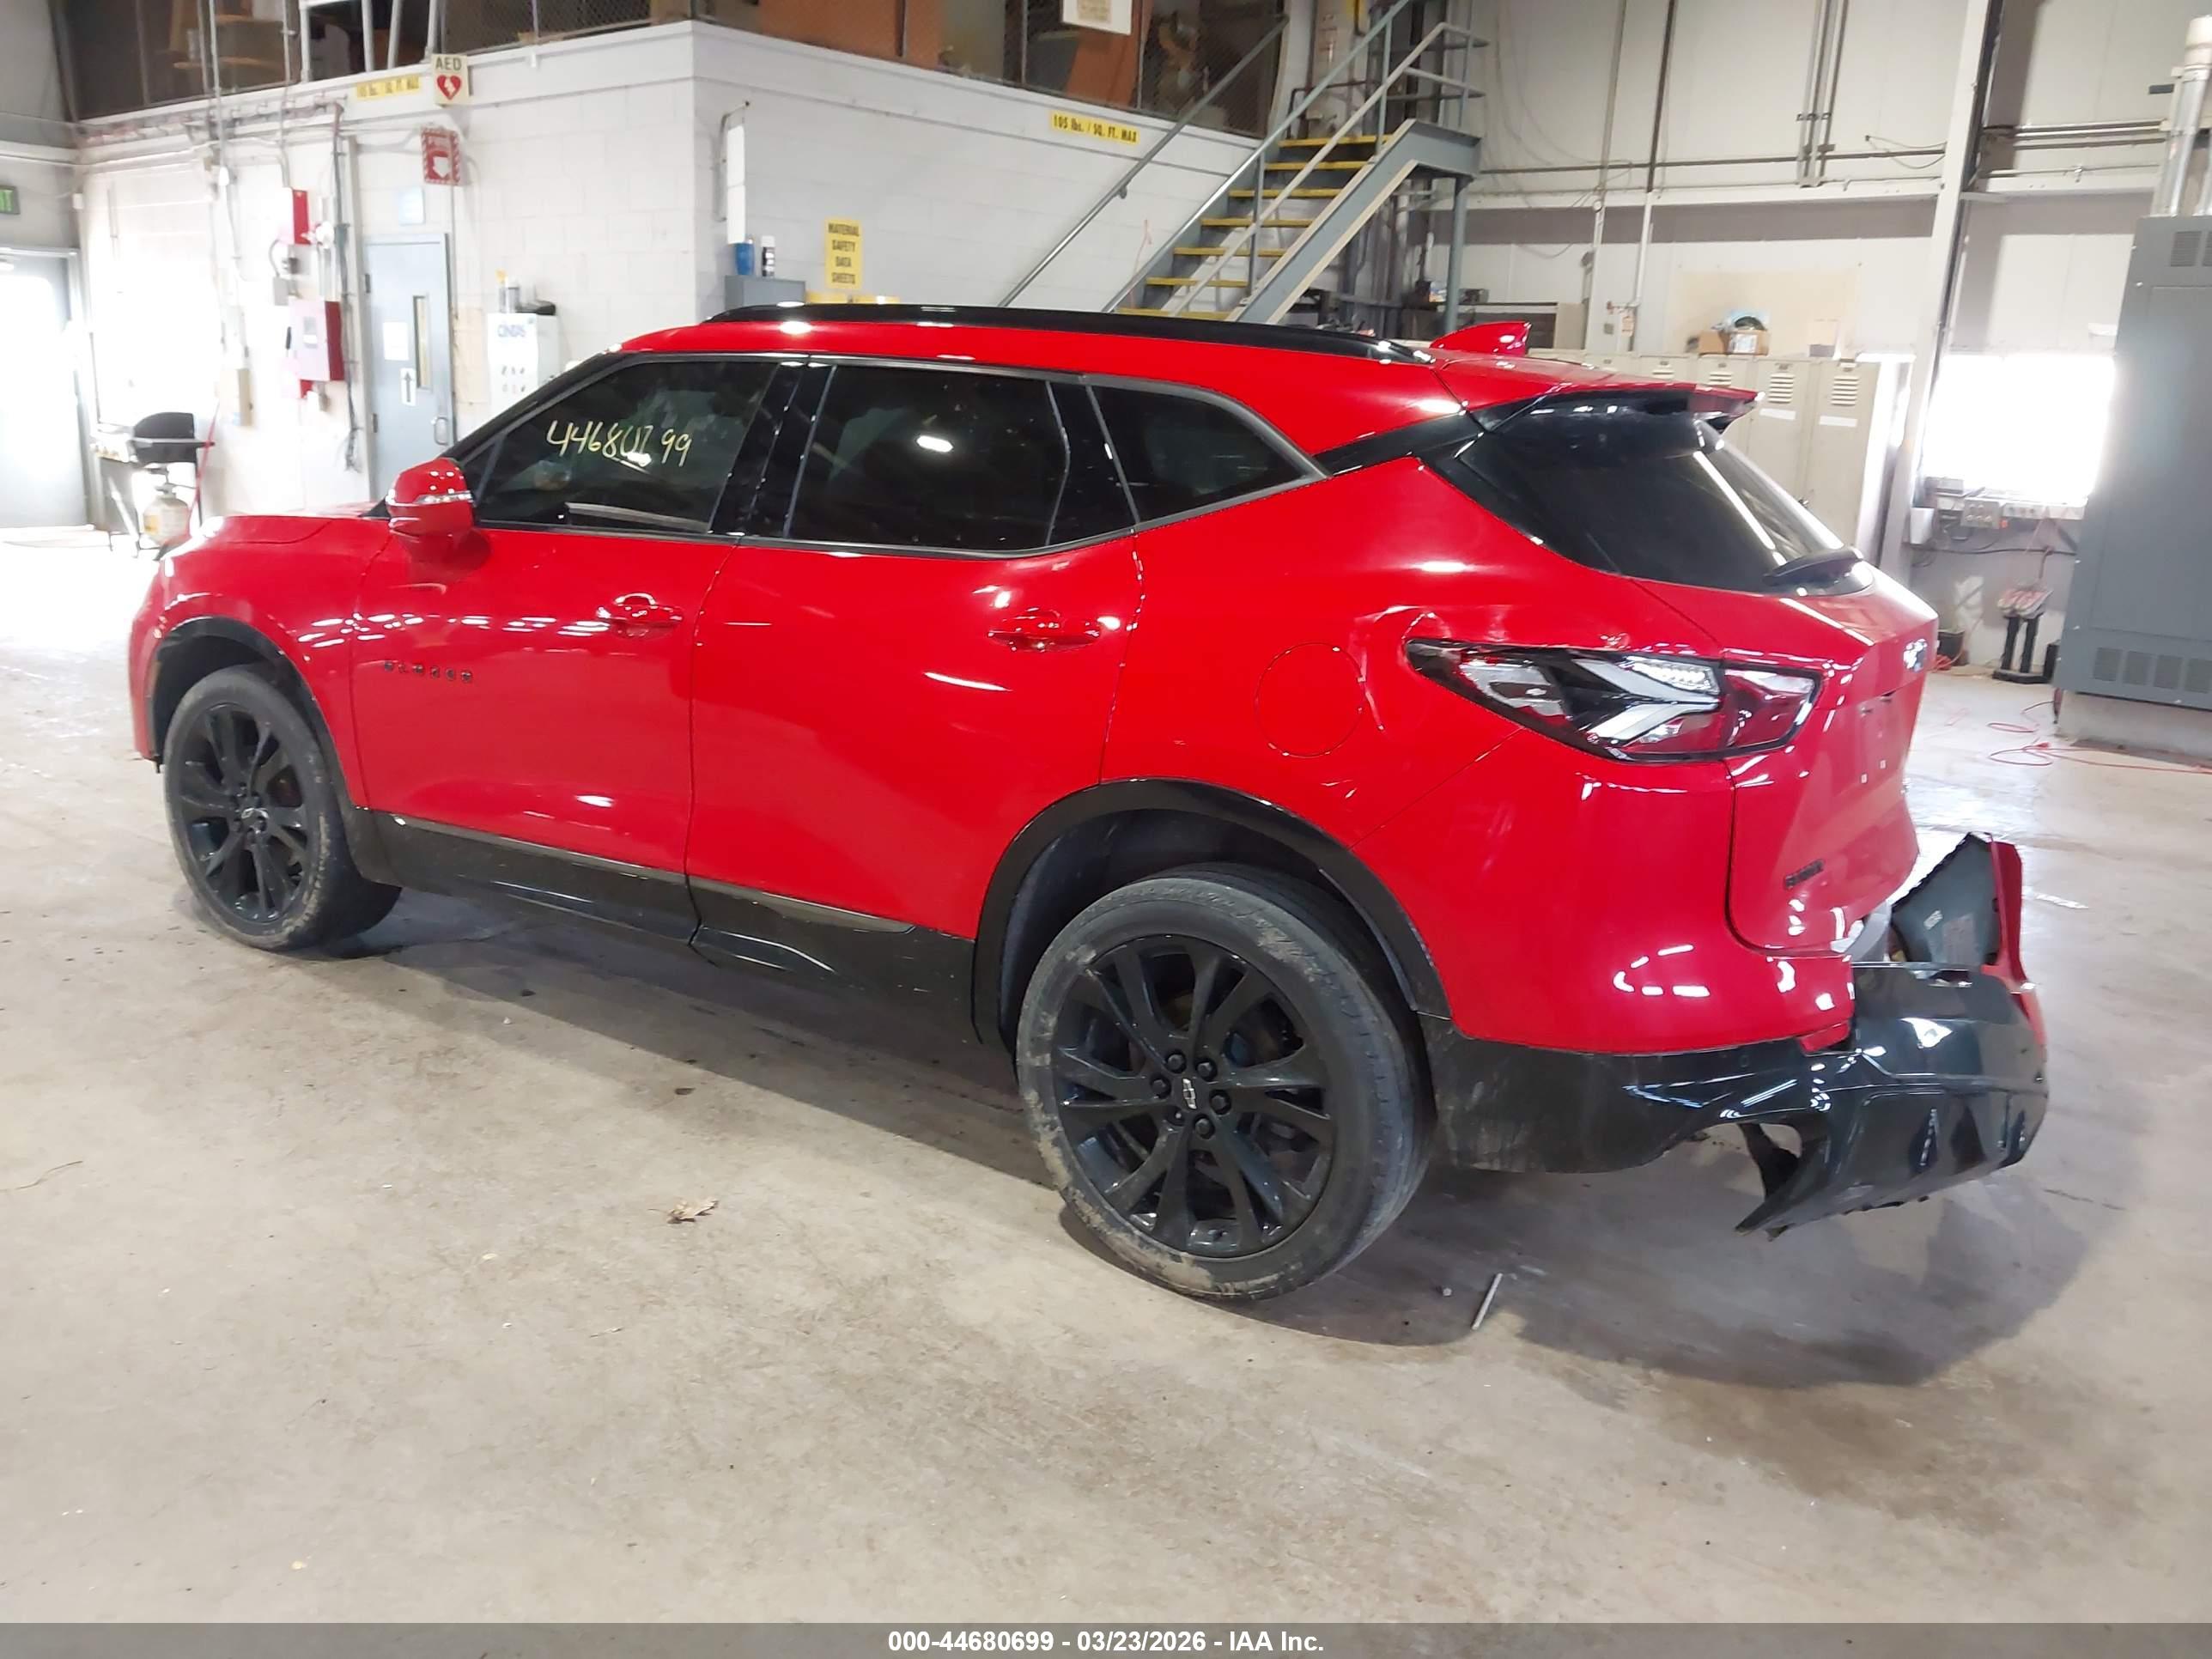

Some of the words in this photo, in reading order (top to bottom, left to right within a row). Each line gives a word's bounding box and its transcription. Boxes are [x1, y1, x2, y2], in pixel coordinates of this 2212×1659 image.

[435, 57, 462, 70] AED
[1054, 114, 1068, 130] 105
[1121, 129, 1137, 143] MAX
